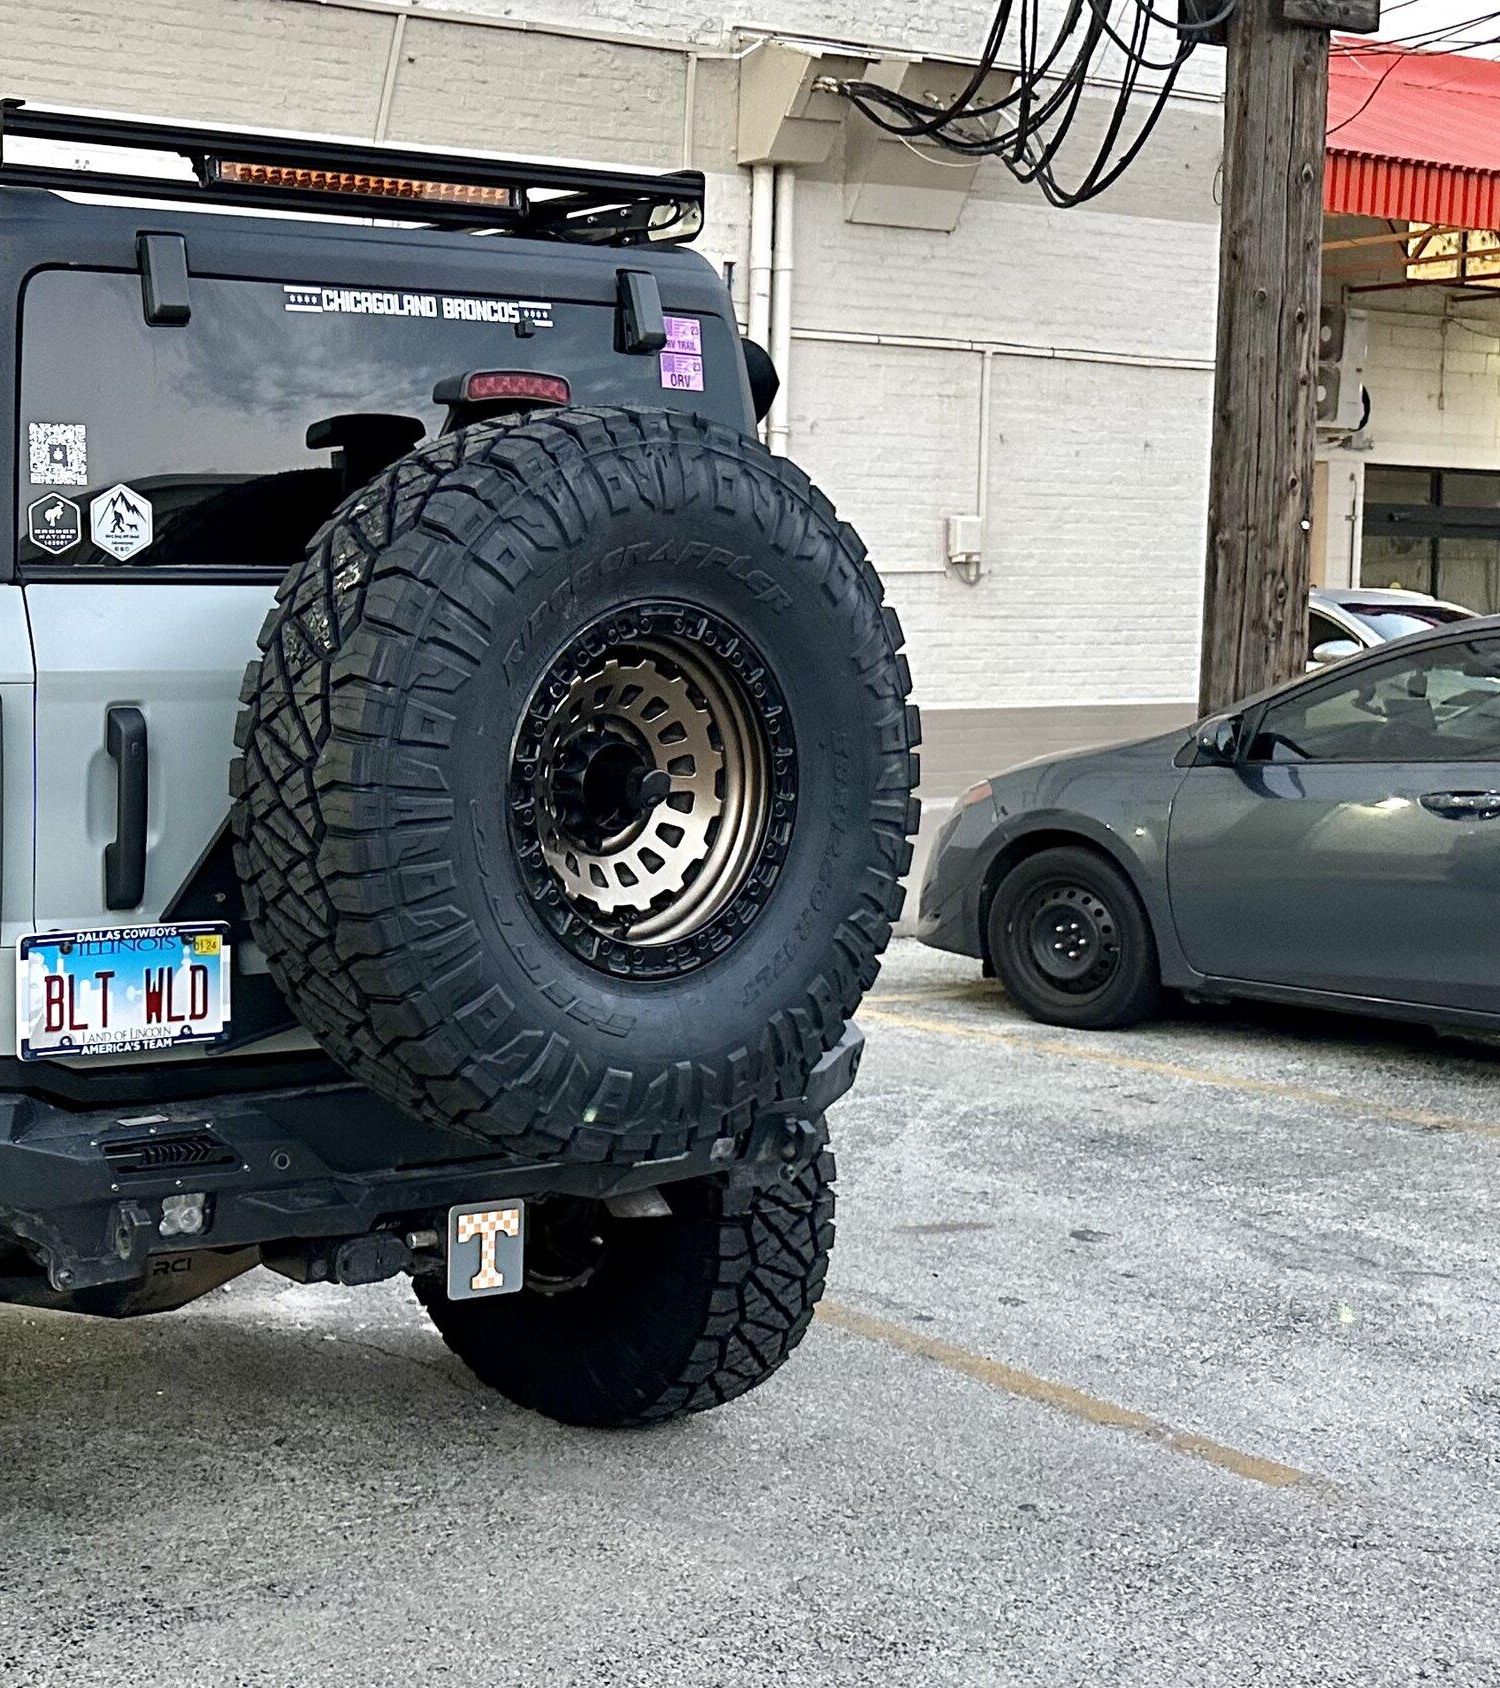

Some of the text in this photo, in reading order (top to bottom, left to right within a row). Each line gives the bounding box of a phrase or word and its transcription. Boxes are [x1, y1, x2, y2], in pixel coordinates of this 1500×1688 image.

[322, 289, 520, 324] CHICAGOLAND BRONCOS
[677, 340, 697, 351] TRAIL
[670, 373, 691, 388] ORV
[76, 926, 177, 943] DALLAS COWBOYS
[78, 938, 176, 956] ILLINOIS
[44, 965, 208, 1033] BLT WLD
[81, 1037, 173, 1056] AMERICA'S TEAM
[457, 1208, 520, 1291] T
[152, 1256, 193, 1276] RCI
